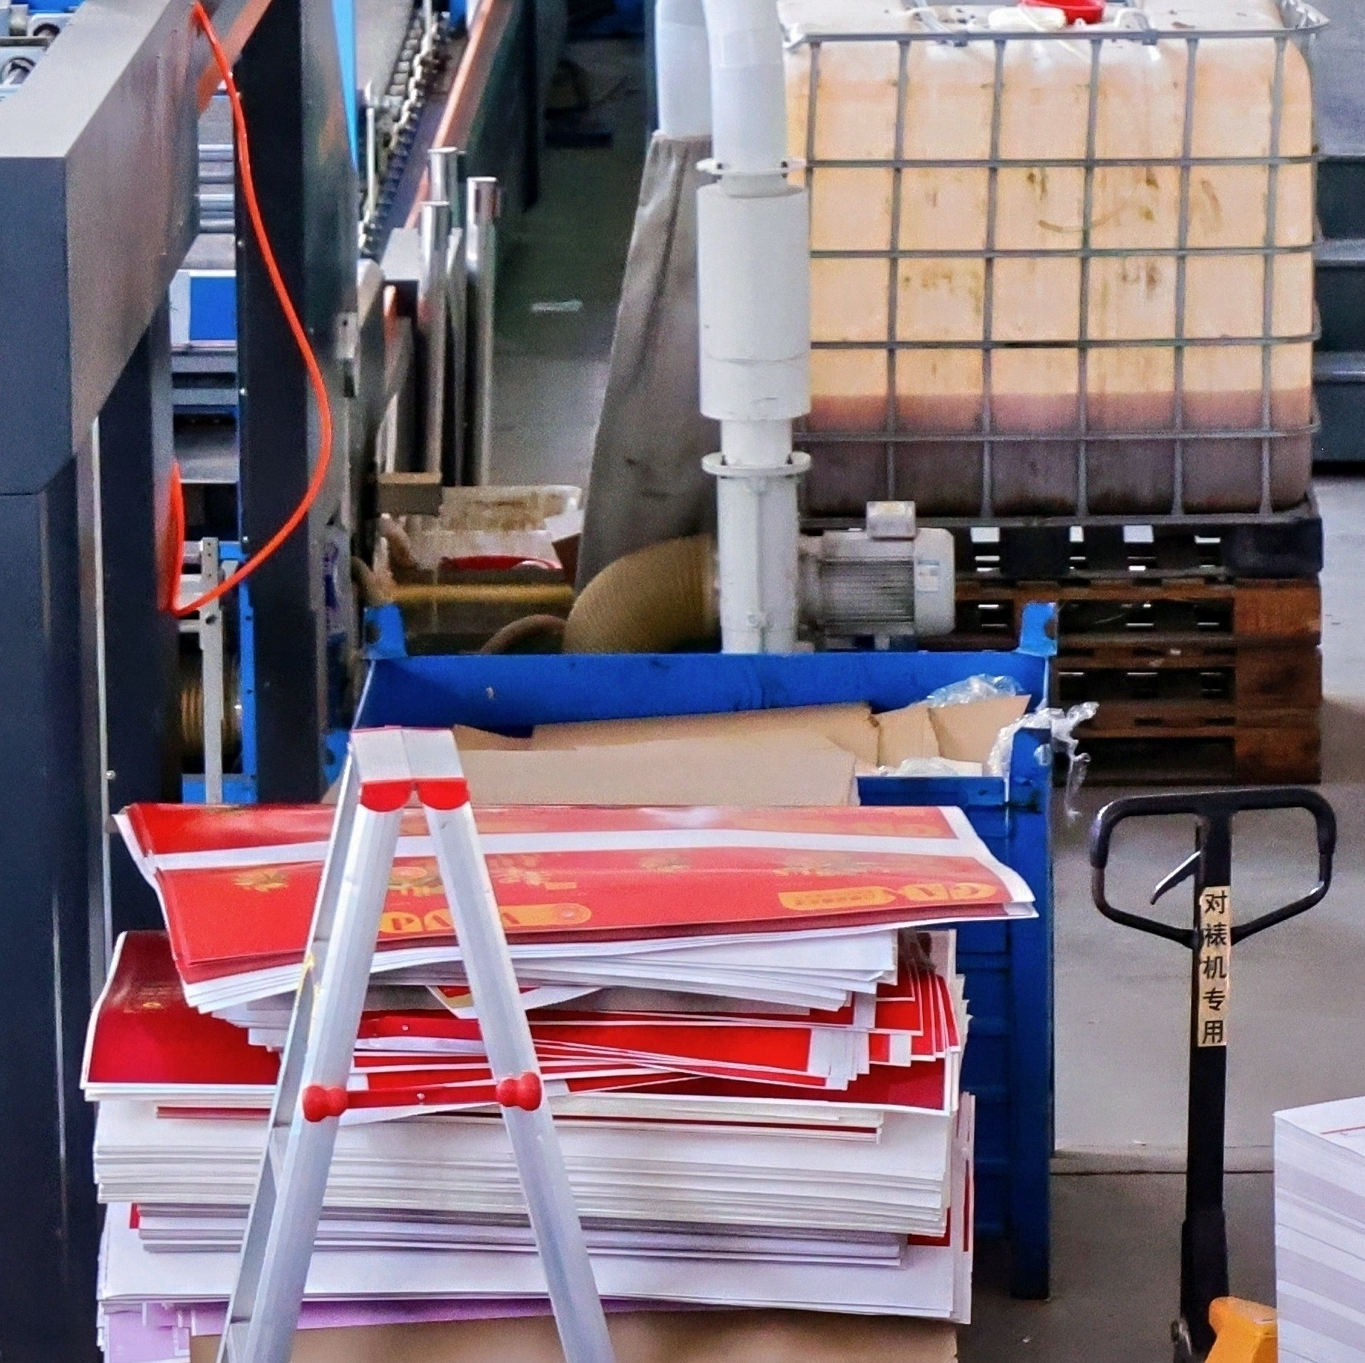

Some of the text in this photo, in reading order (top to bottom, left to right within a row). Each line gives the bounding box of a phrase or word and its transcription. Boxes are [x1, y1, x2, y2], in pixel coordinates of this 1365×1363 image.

[1202, 890, 1228, 1045] 对裱机专用
